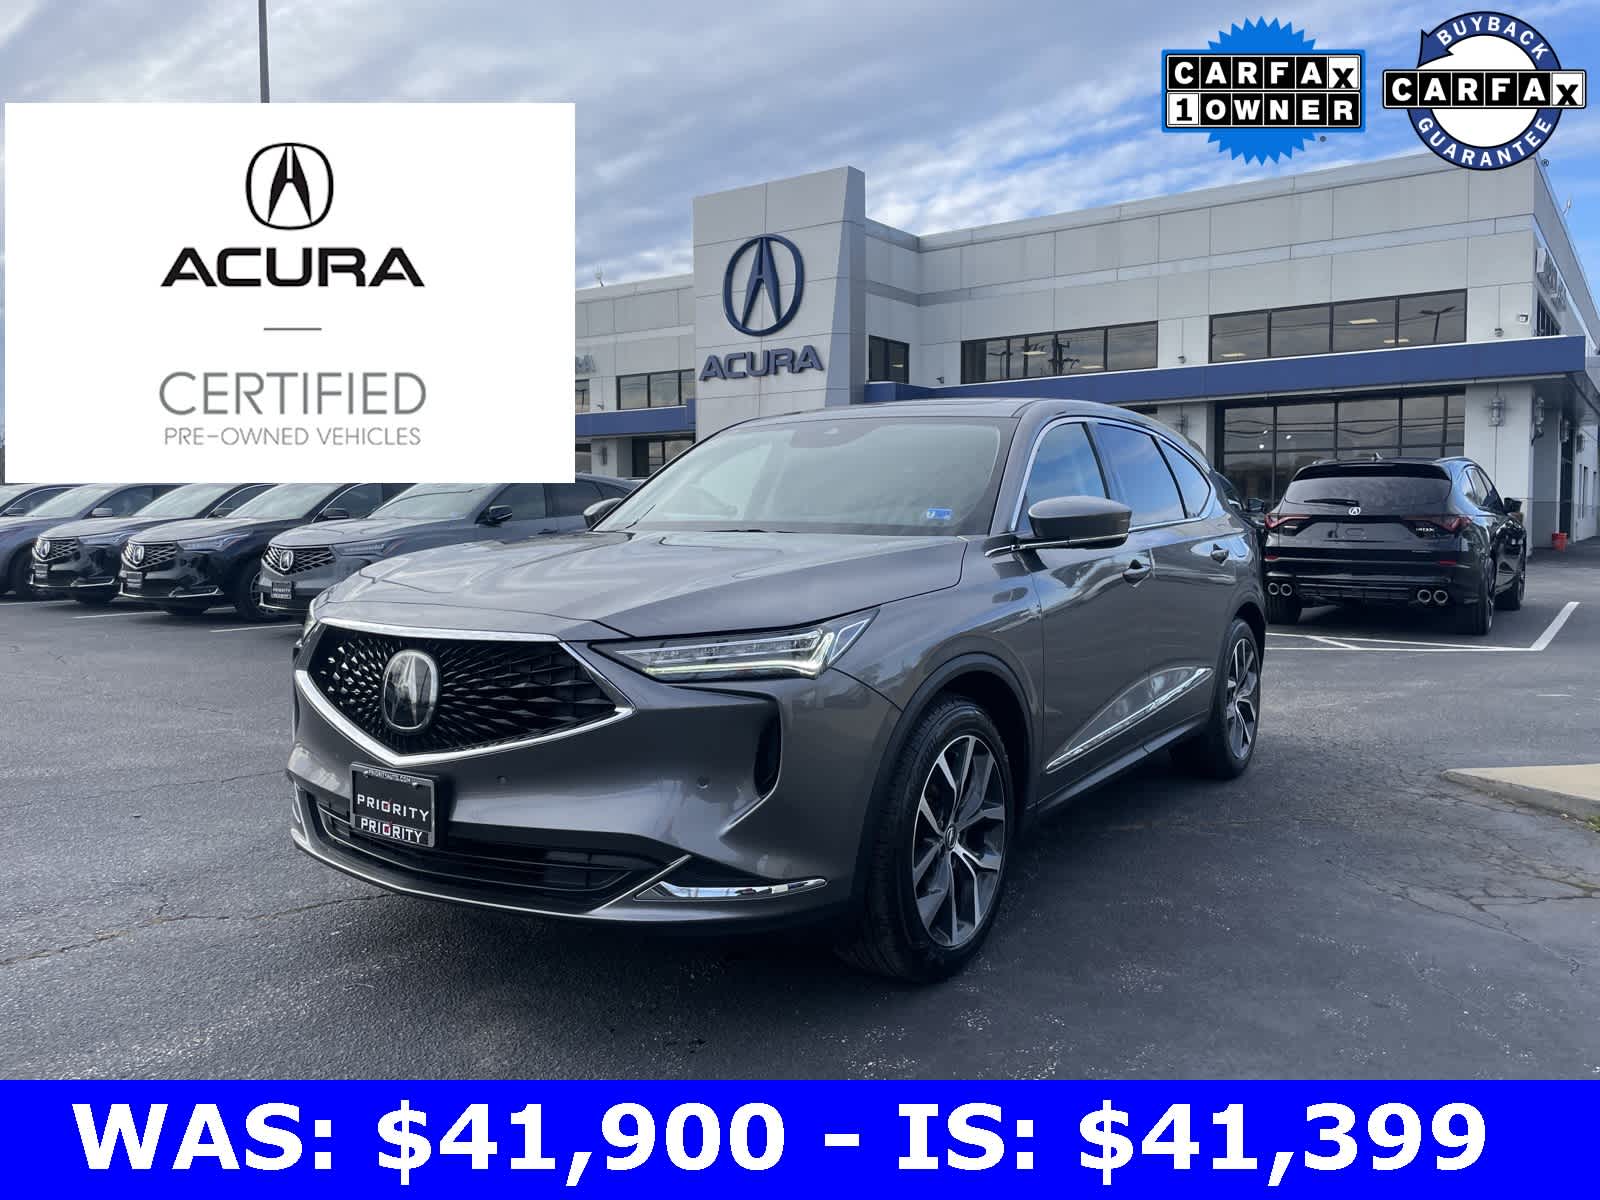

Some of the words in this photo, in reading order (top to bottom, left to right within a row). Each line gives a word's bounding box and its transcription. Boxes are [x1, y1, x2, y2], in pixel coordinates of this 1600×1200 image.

[699, 344, 824, 382] ACURA
[357, 793, 430, 822] PRIORITY
[360, 817, 423, 844] PRIORITY
